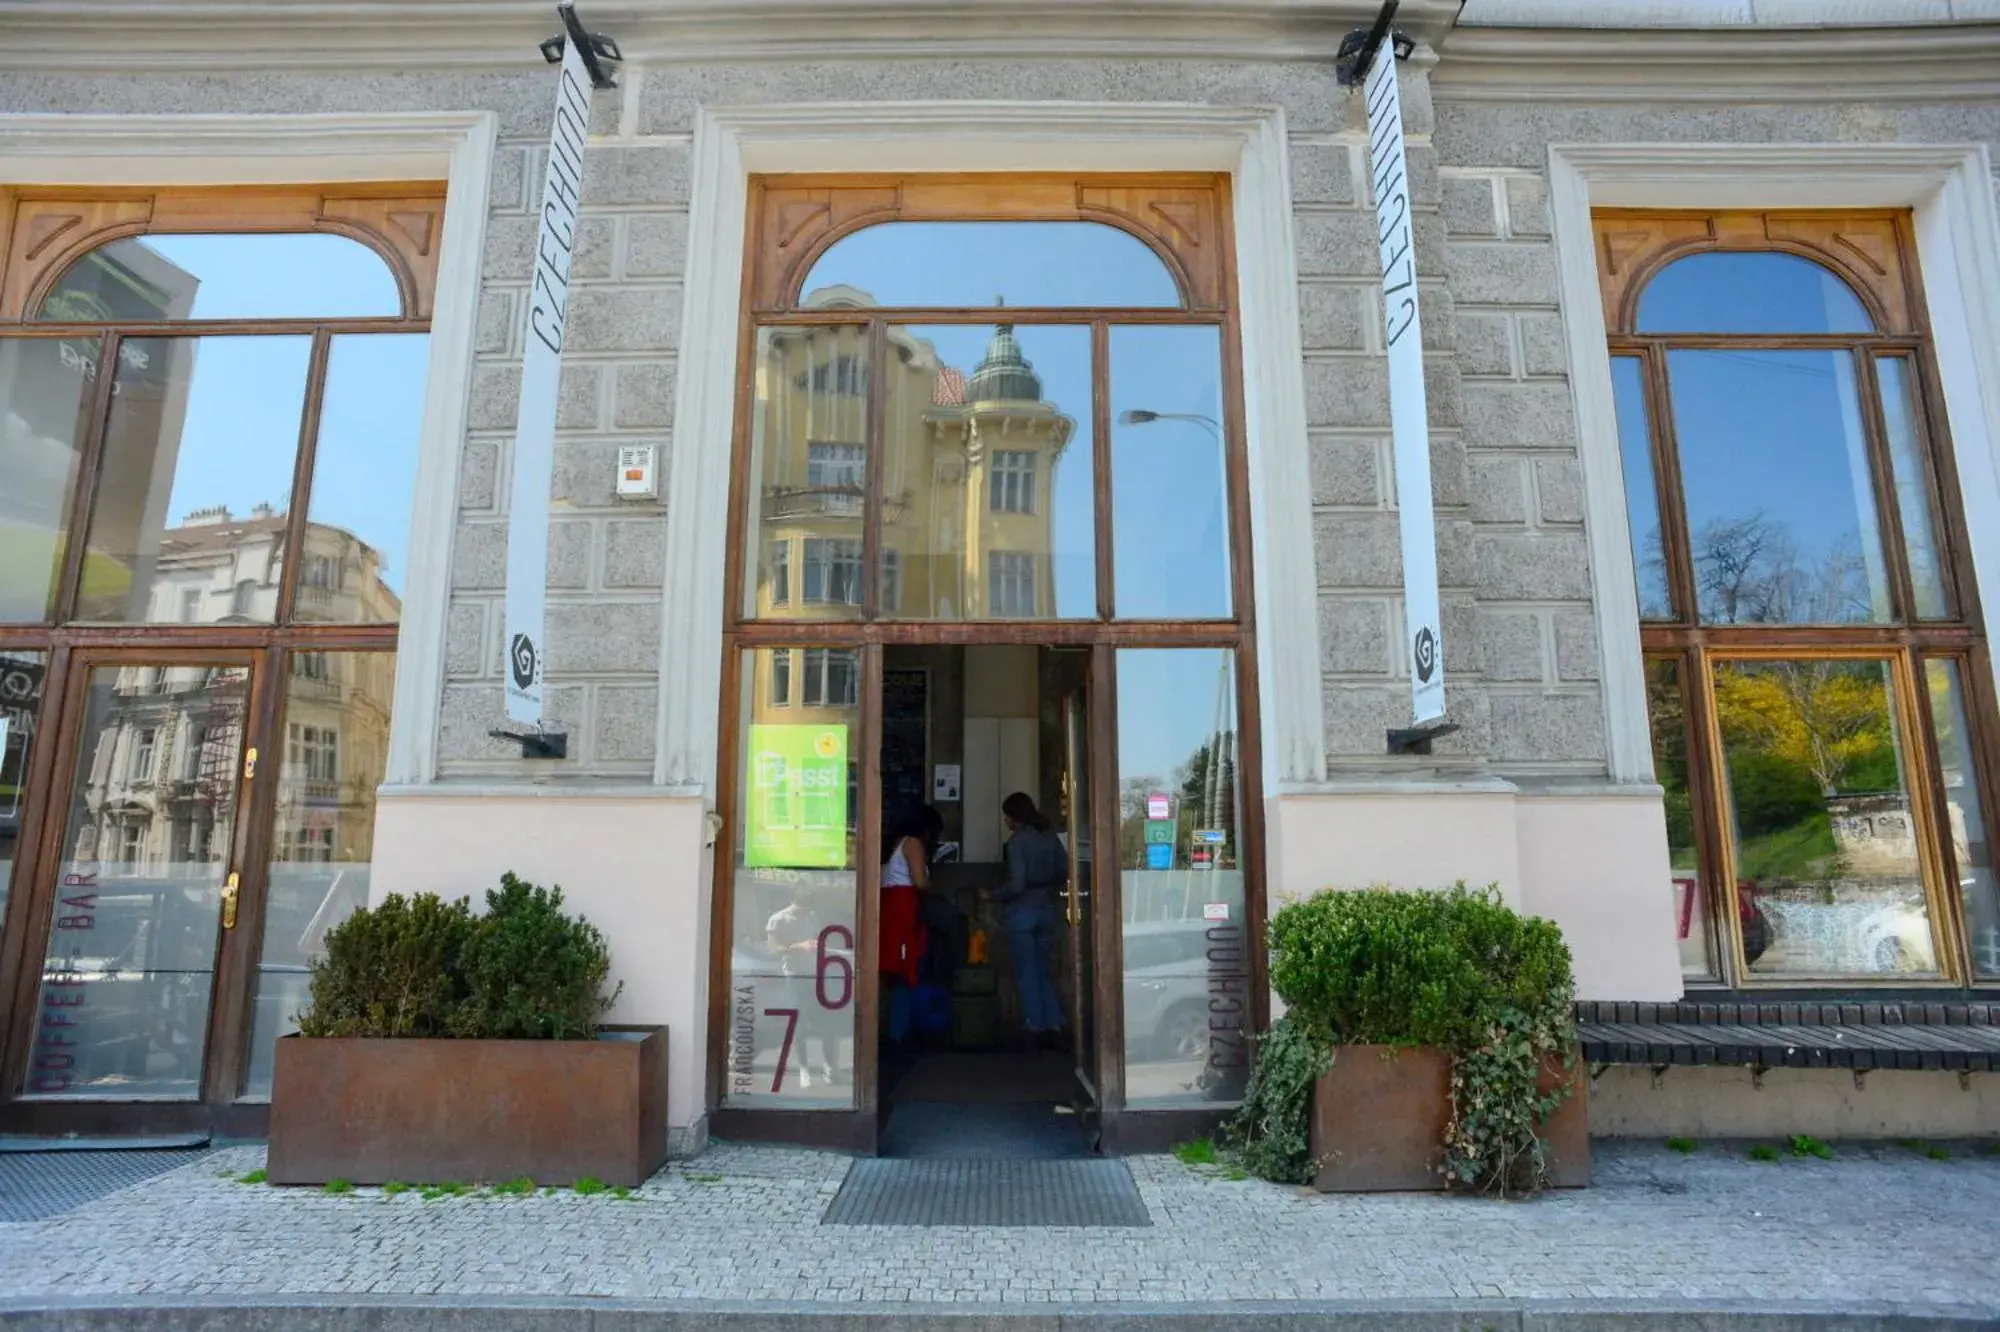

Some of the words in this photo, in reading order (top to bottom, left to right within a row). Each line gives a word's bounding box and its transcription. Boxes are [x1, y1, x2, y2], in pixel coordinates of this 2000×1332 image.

[531, 67, 588, 355] CZECHINN
[58, 872, 97, 929] BAR
[764, 1008, 799, 1093] 7
[1206, 926, 1245, 1069] CZECHINN
